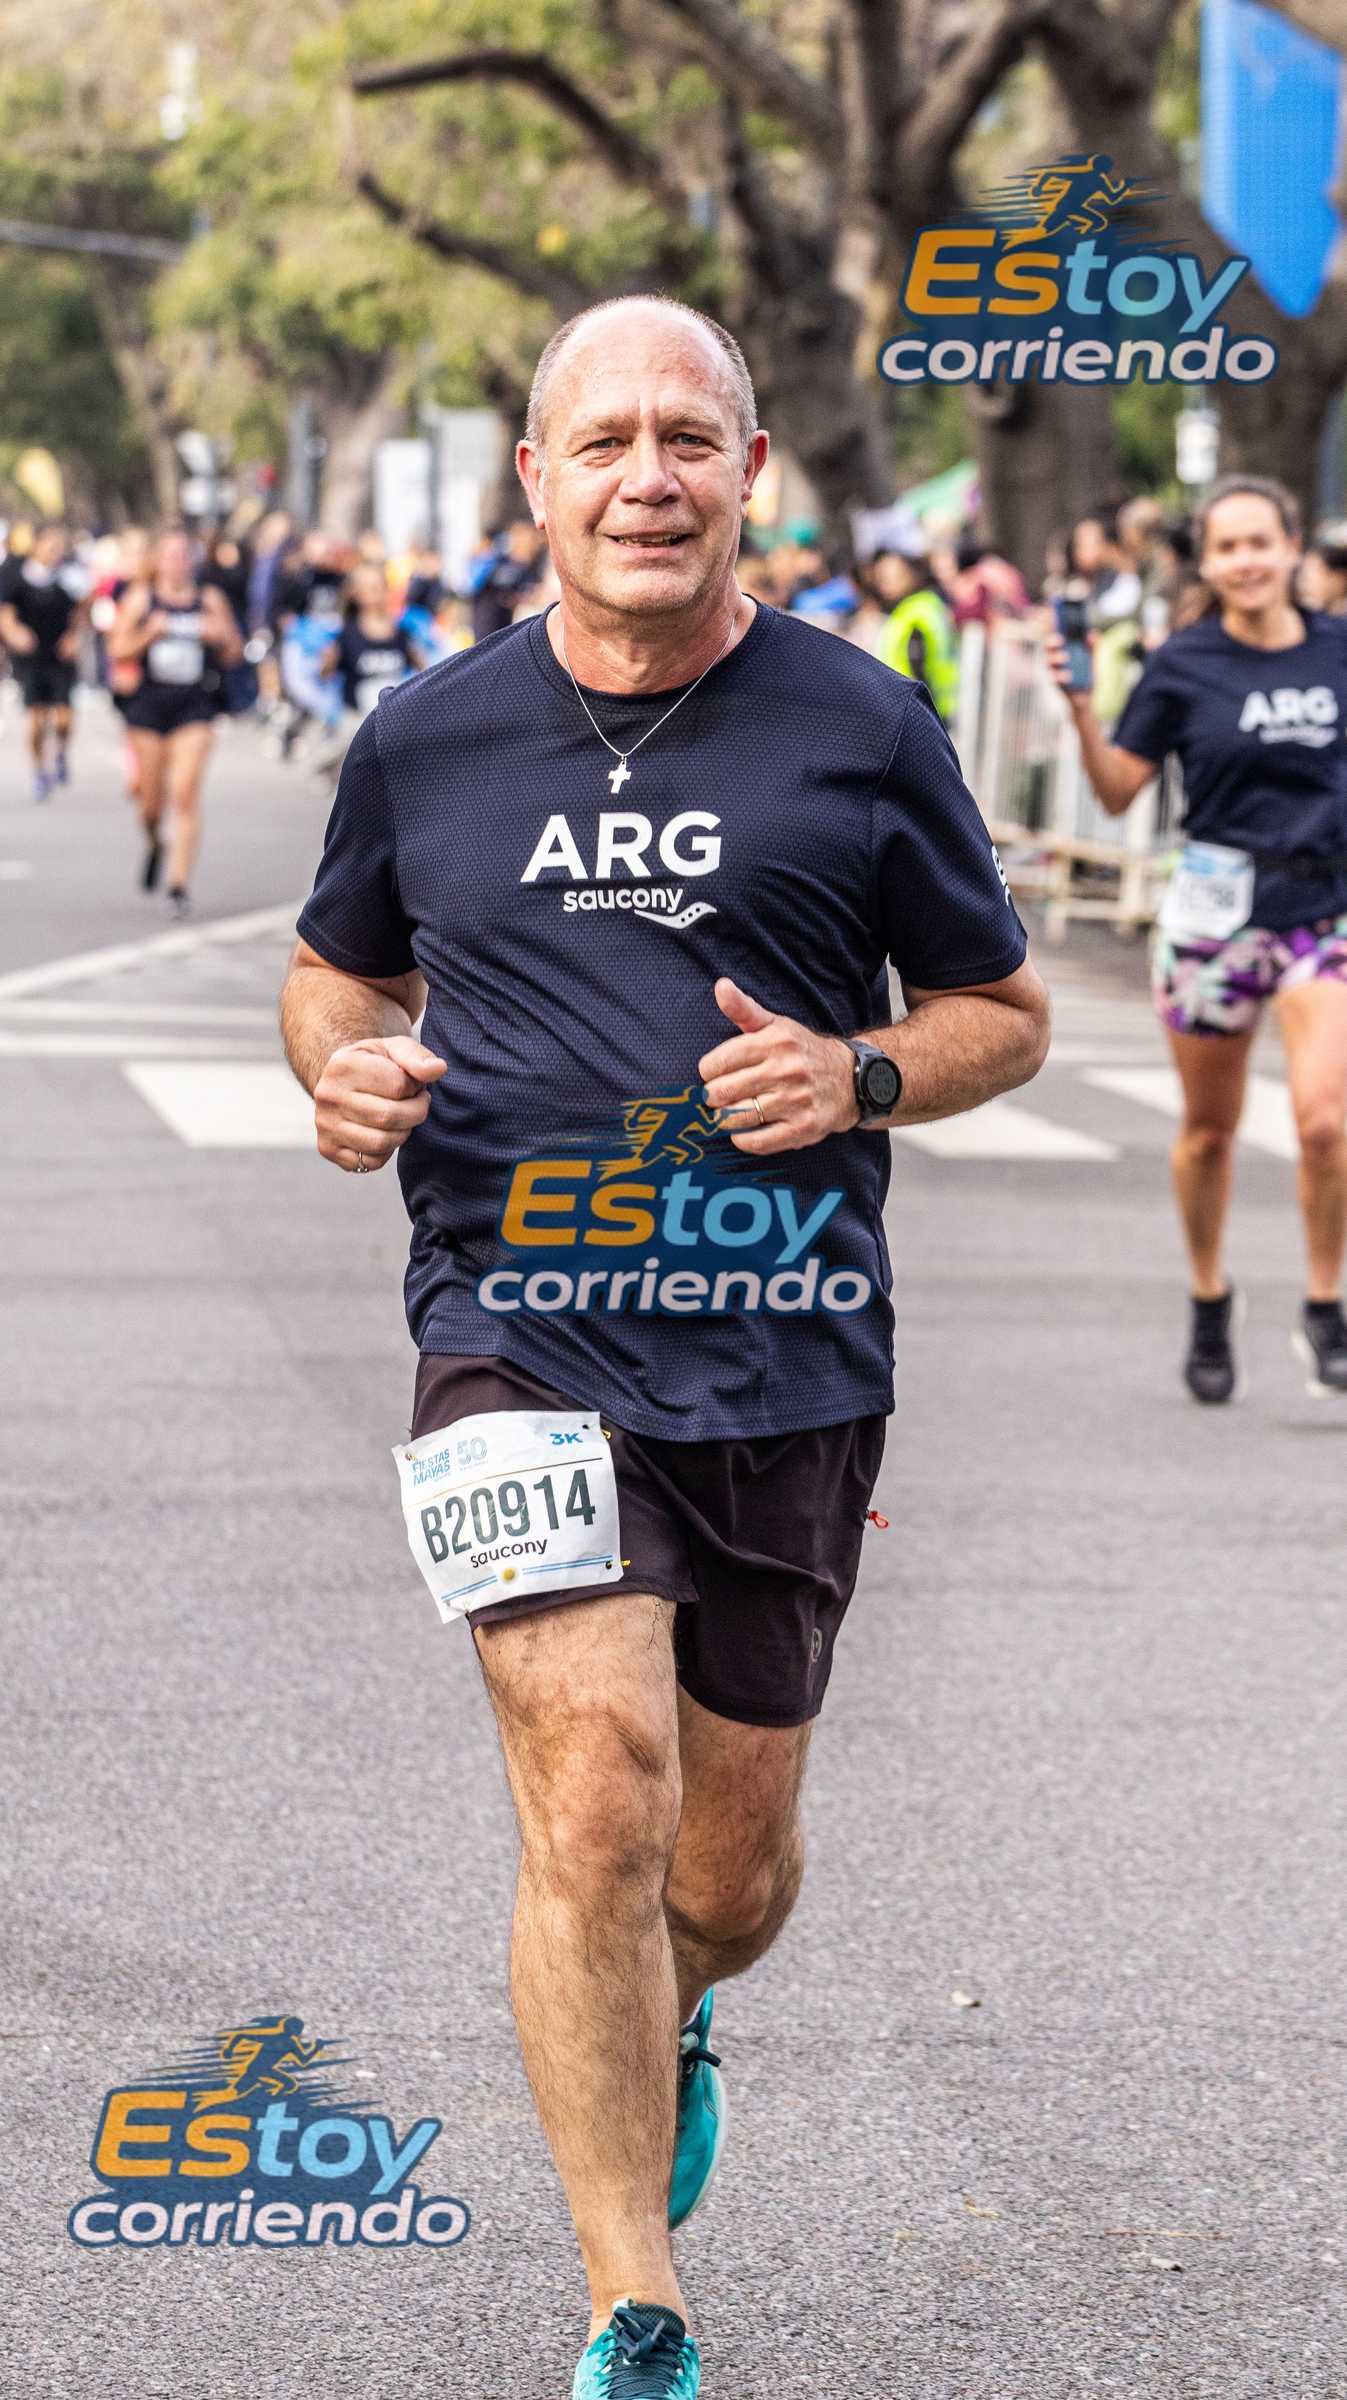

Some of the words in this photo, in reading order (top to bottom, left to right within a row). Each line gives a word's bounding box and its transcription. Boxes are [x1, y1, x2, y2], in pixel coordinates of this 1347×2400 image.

[1238, 686, 1339, 732] ARG
[520, 810, 722, 883] ARG
[562, 887, 684, 914] saucony
[456, 1436, 488, 1465] 50
[550, 1432, 584, 1446] 3K
[413, 1460, 450, 1488] MAYAS
[420, 1469, 597, 1564] B20914
[470, 1539, 549, 1569] saucony
